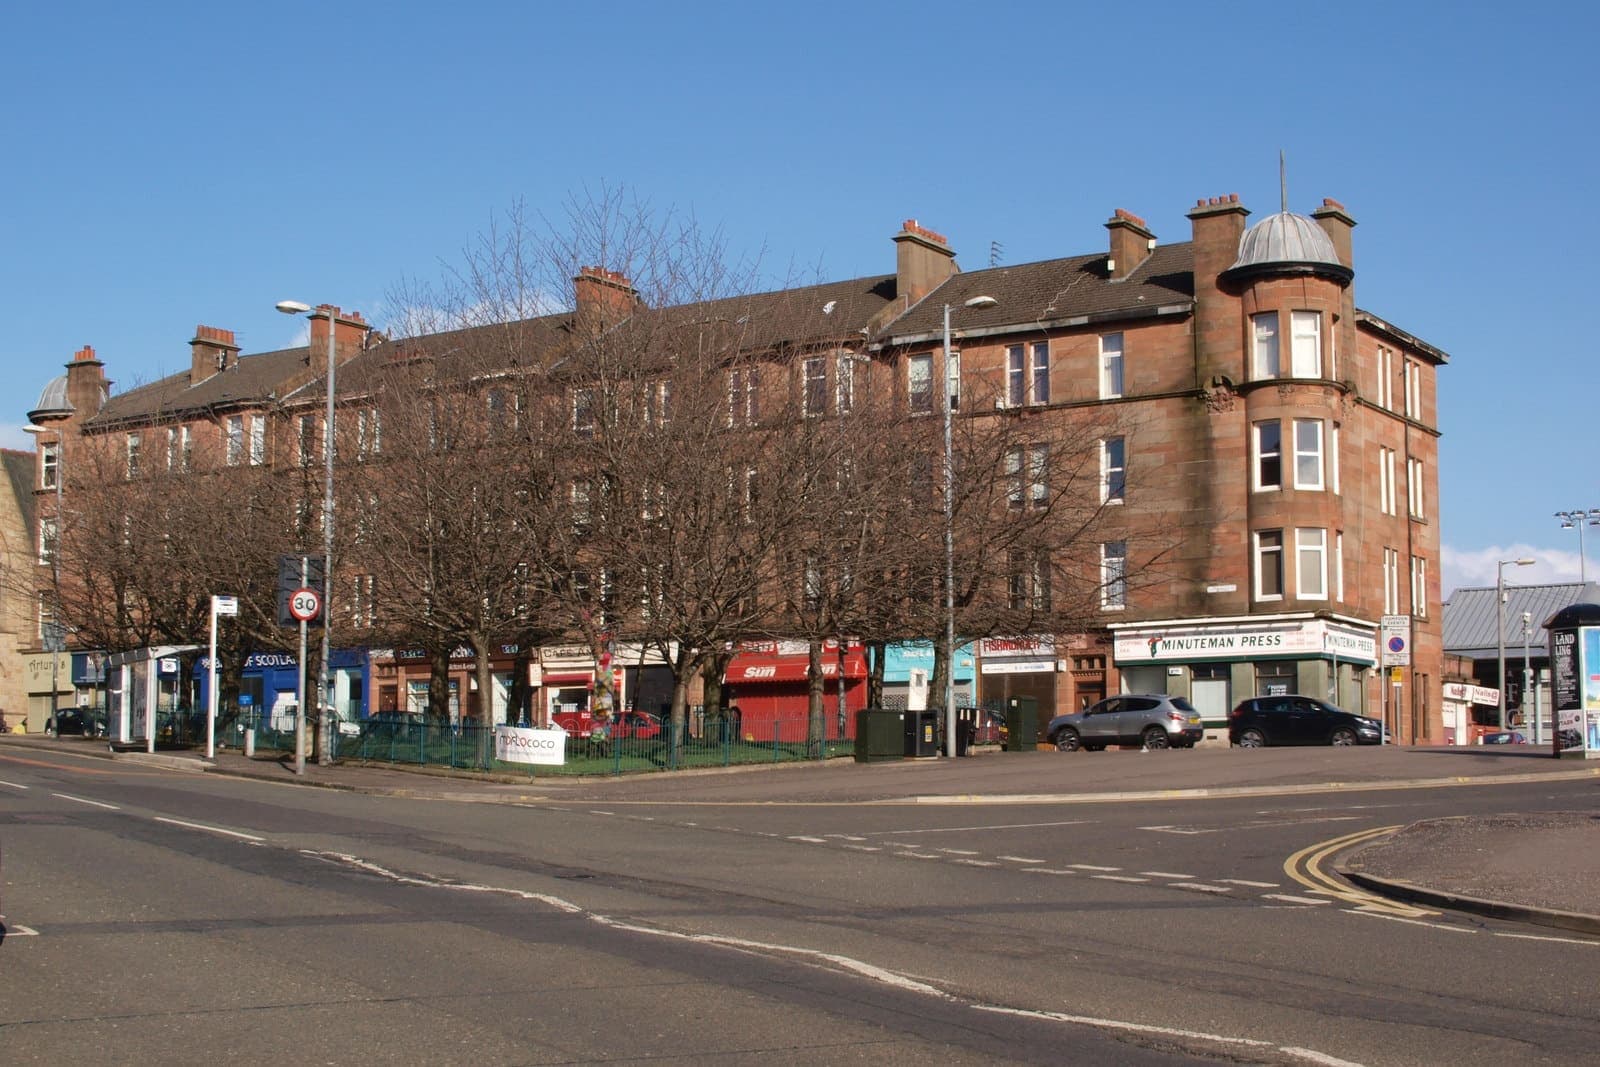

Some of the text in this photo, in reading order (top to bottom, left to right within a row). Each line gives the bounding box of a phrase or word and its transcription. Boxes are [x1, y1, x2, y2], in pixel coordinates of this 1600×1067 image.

[295, 597, 316, 611] 30
[1161, 637, 1234, 651] MINUTEMAN
[1241, 634, 1281, 648] PRESS
[1328, 633, 1357, 650] MINUTEMAN
[1358, 639, 1373, 651] PRESS
[1555, 633, 1575, 645] LAND
[743, 666, 776, 679] Sun
